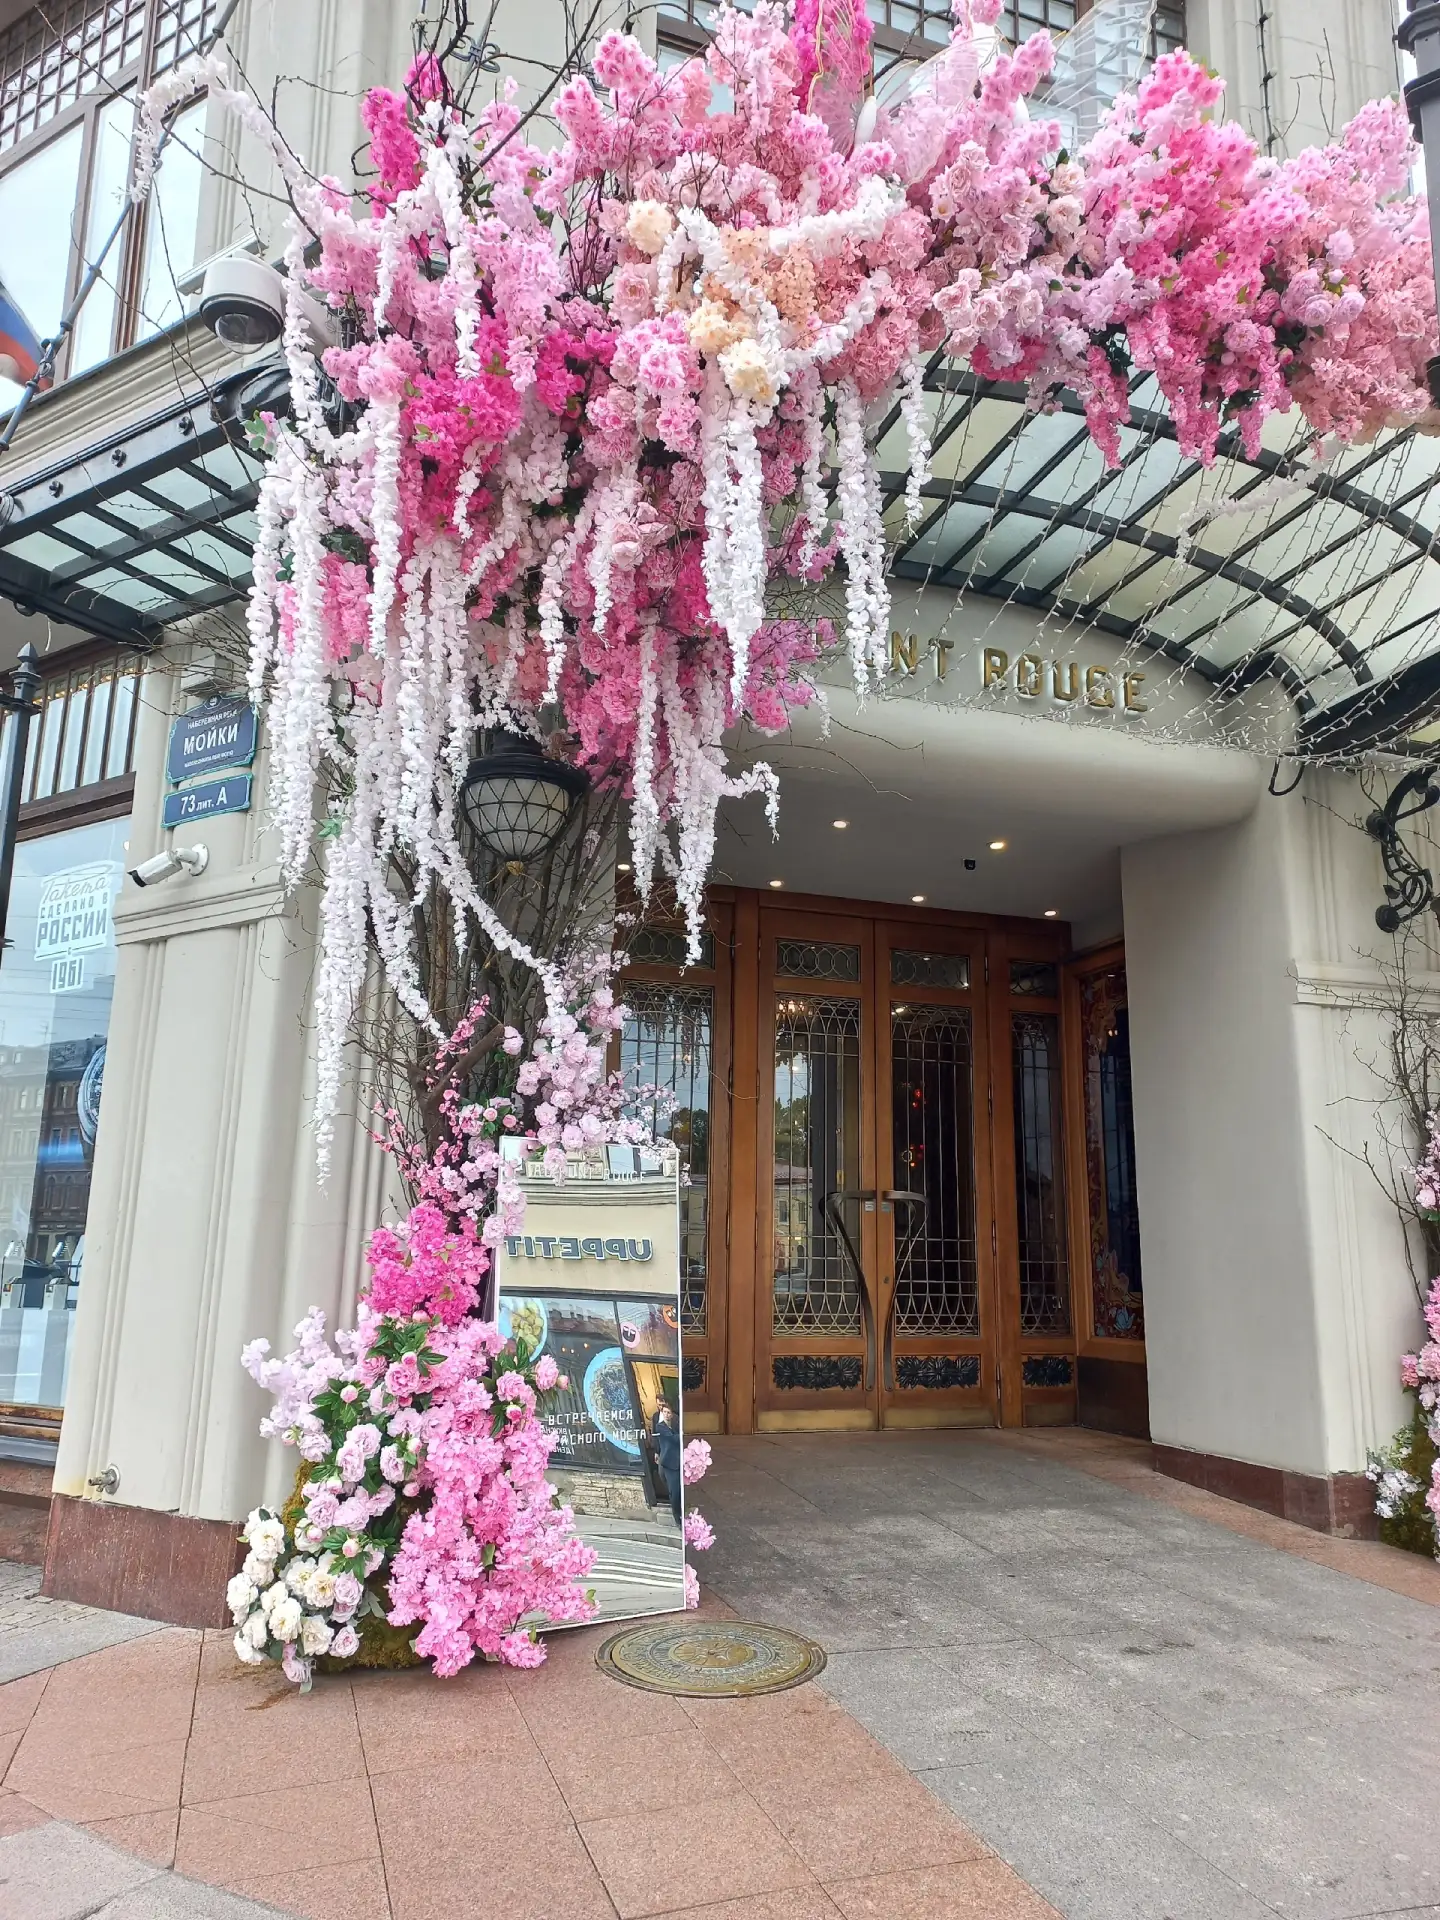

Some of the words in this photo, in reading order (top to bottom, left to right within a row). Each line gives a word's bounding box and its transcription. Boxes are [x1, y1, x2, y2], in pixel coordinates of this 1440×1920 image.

[983, 647, 1148, 712] ROUGE
[187, 713, 223, 729] НАБЕРЕЖНАЯ
[183, 722, 238, 756] МОЙКИ
[181, 794, 196, 815] 73
[40, 896, 94, 919] СДЕЛАНО
[36, 908, 107, 948] РОССИИ
[52, 958, 83, 990] 1961
[548, 1409, 633, 1426] ВСТРЕЧАЕМСЯ
[613, 1428, 647, 1441] МОСТА
